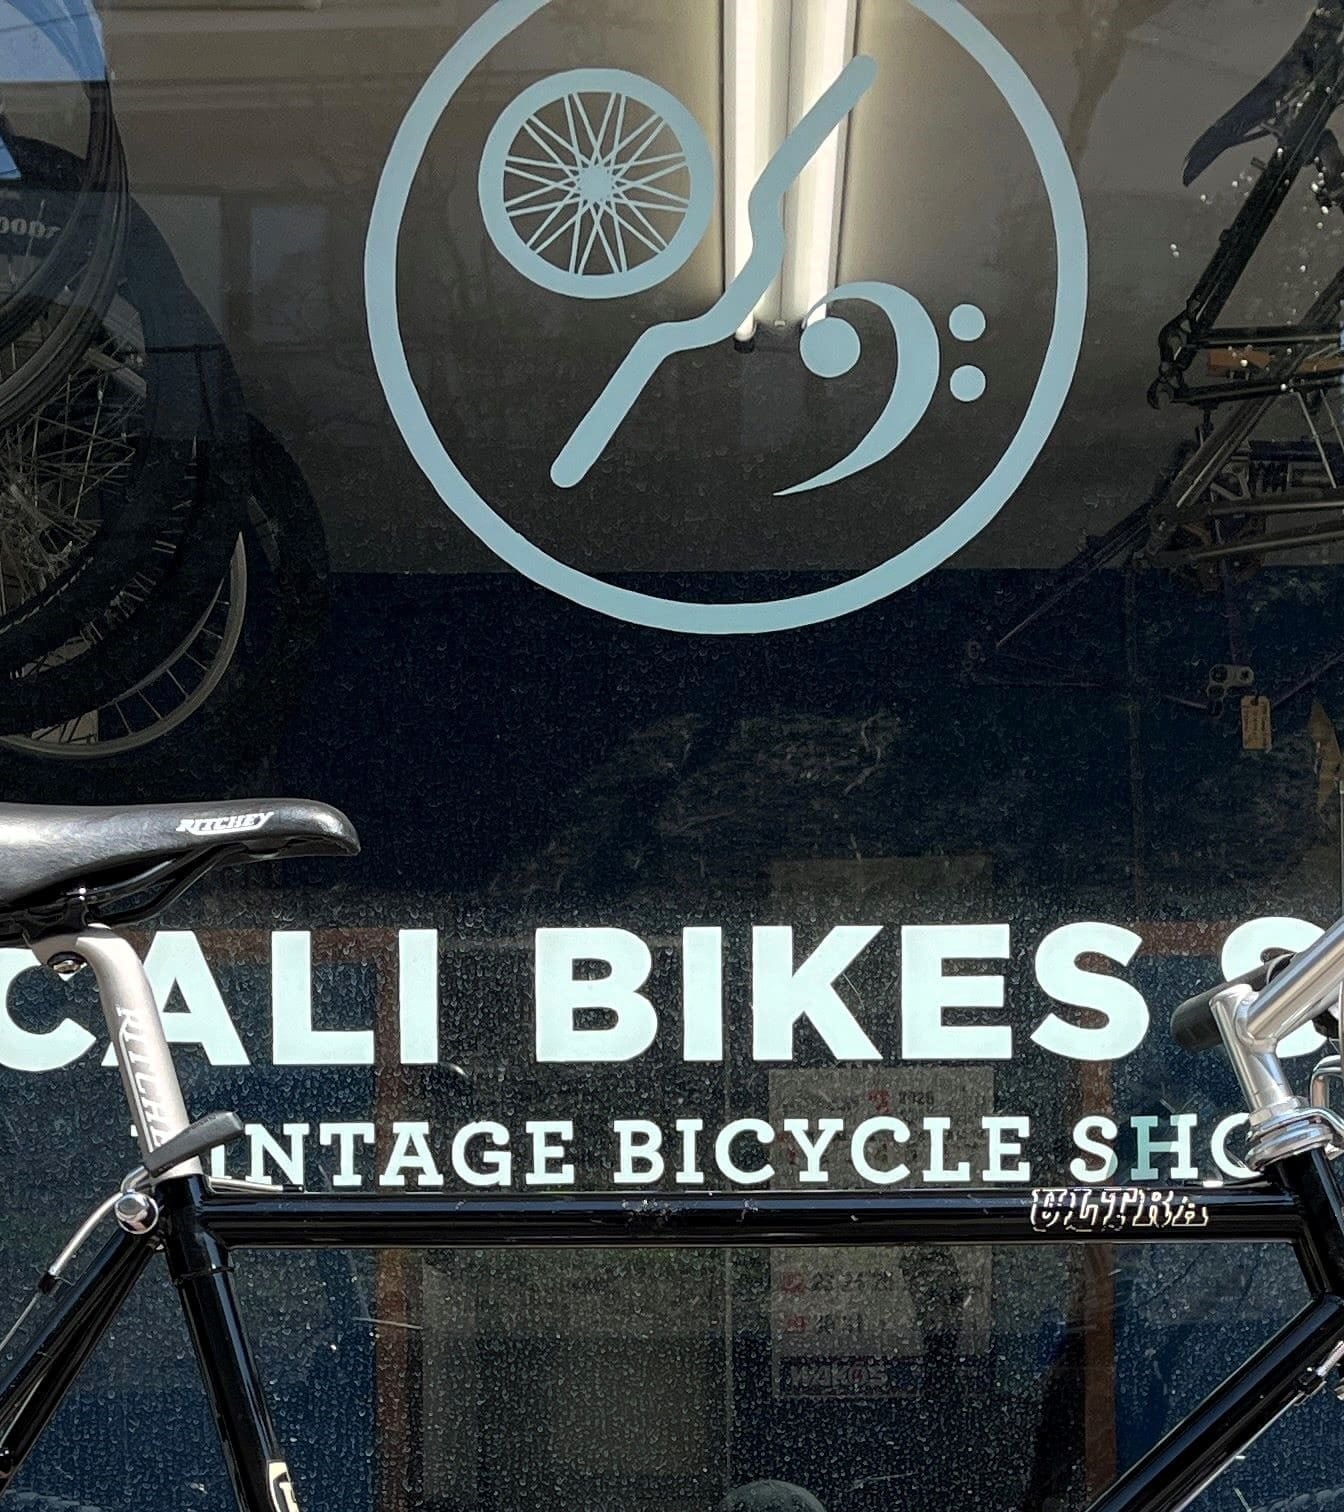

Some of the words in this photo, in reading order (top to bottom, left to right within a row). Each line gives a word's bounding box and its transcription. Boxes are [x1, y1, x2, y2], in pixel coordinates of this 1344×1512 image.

[176, 811, 276, 835] RITCHEY
[534, 921, 1151, 1063] BIKES
[131, 1120, 575, 1188] NTAGE
[613, 1115, 1031, 1185] BICYCLE
[1070, 1112, 1266, 1183] SHO
[1030, 1187, 1209, 1233] ULTRA
